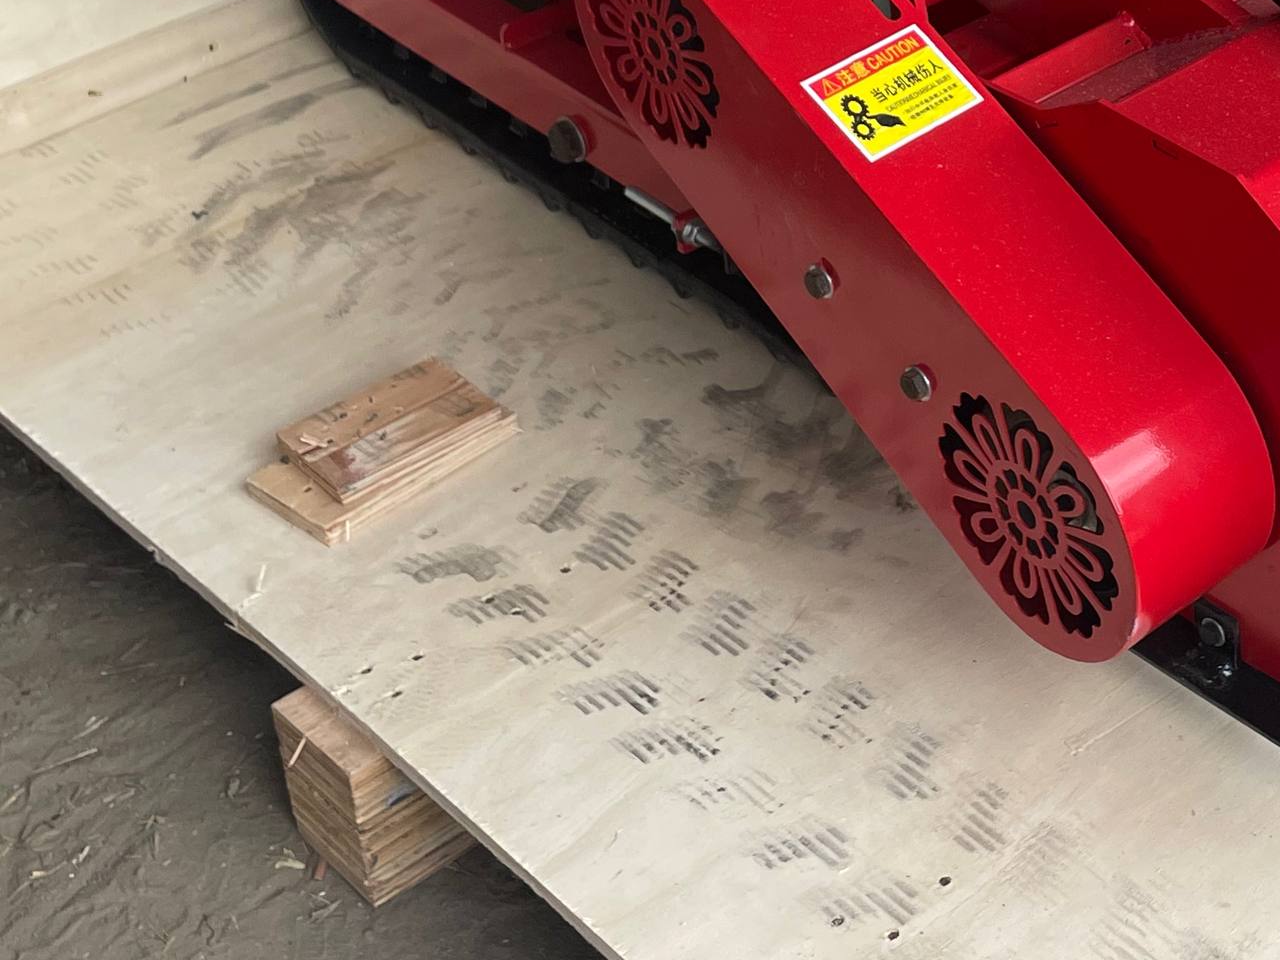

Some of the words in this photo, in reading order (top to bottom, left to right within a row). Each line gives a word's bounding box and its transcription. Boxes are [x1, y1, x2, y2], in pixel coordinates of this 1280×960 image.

[838, 60, 871, 86] 注意
[867, 37, 920, 70] CAUTION
[870, 59, 944, 103] 当心机械伤人
